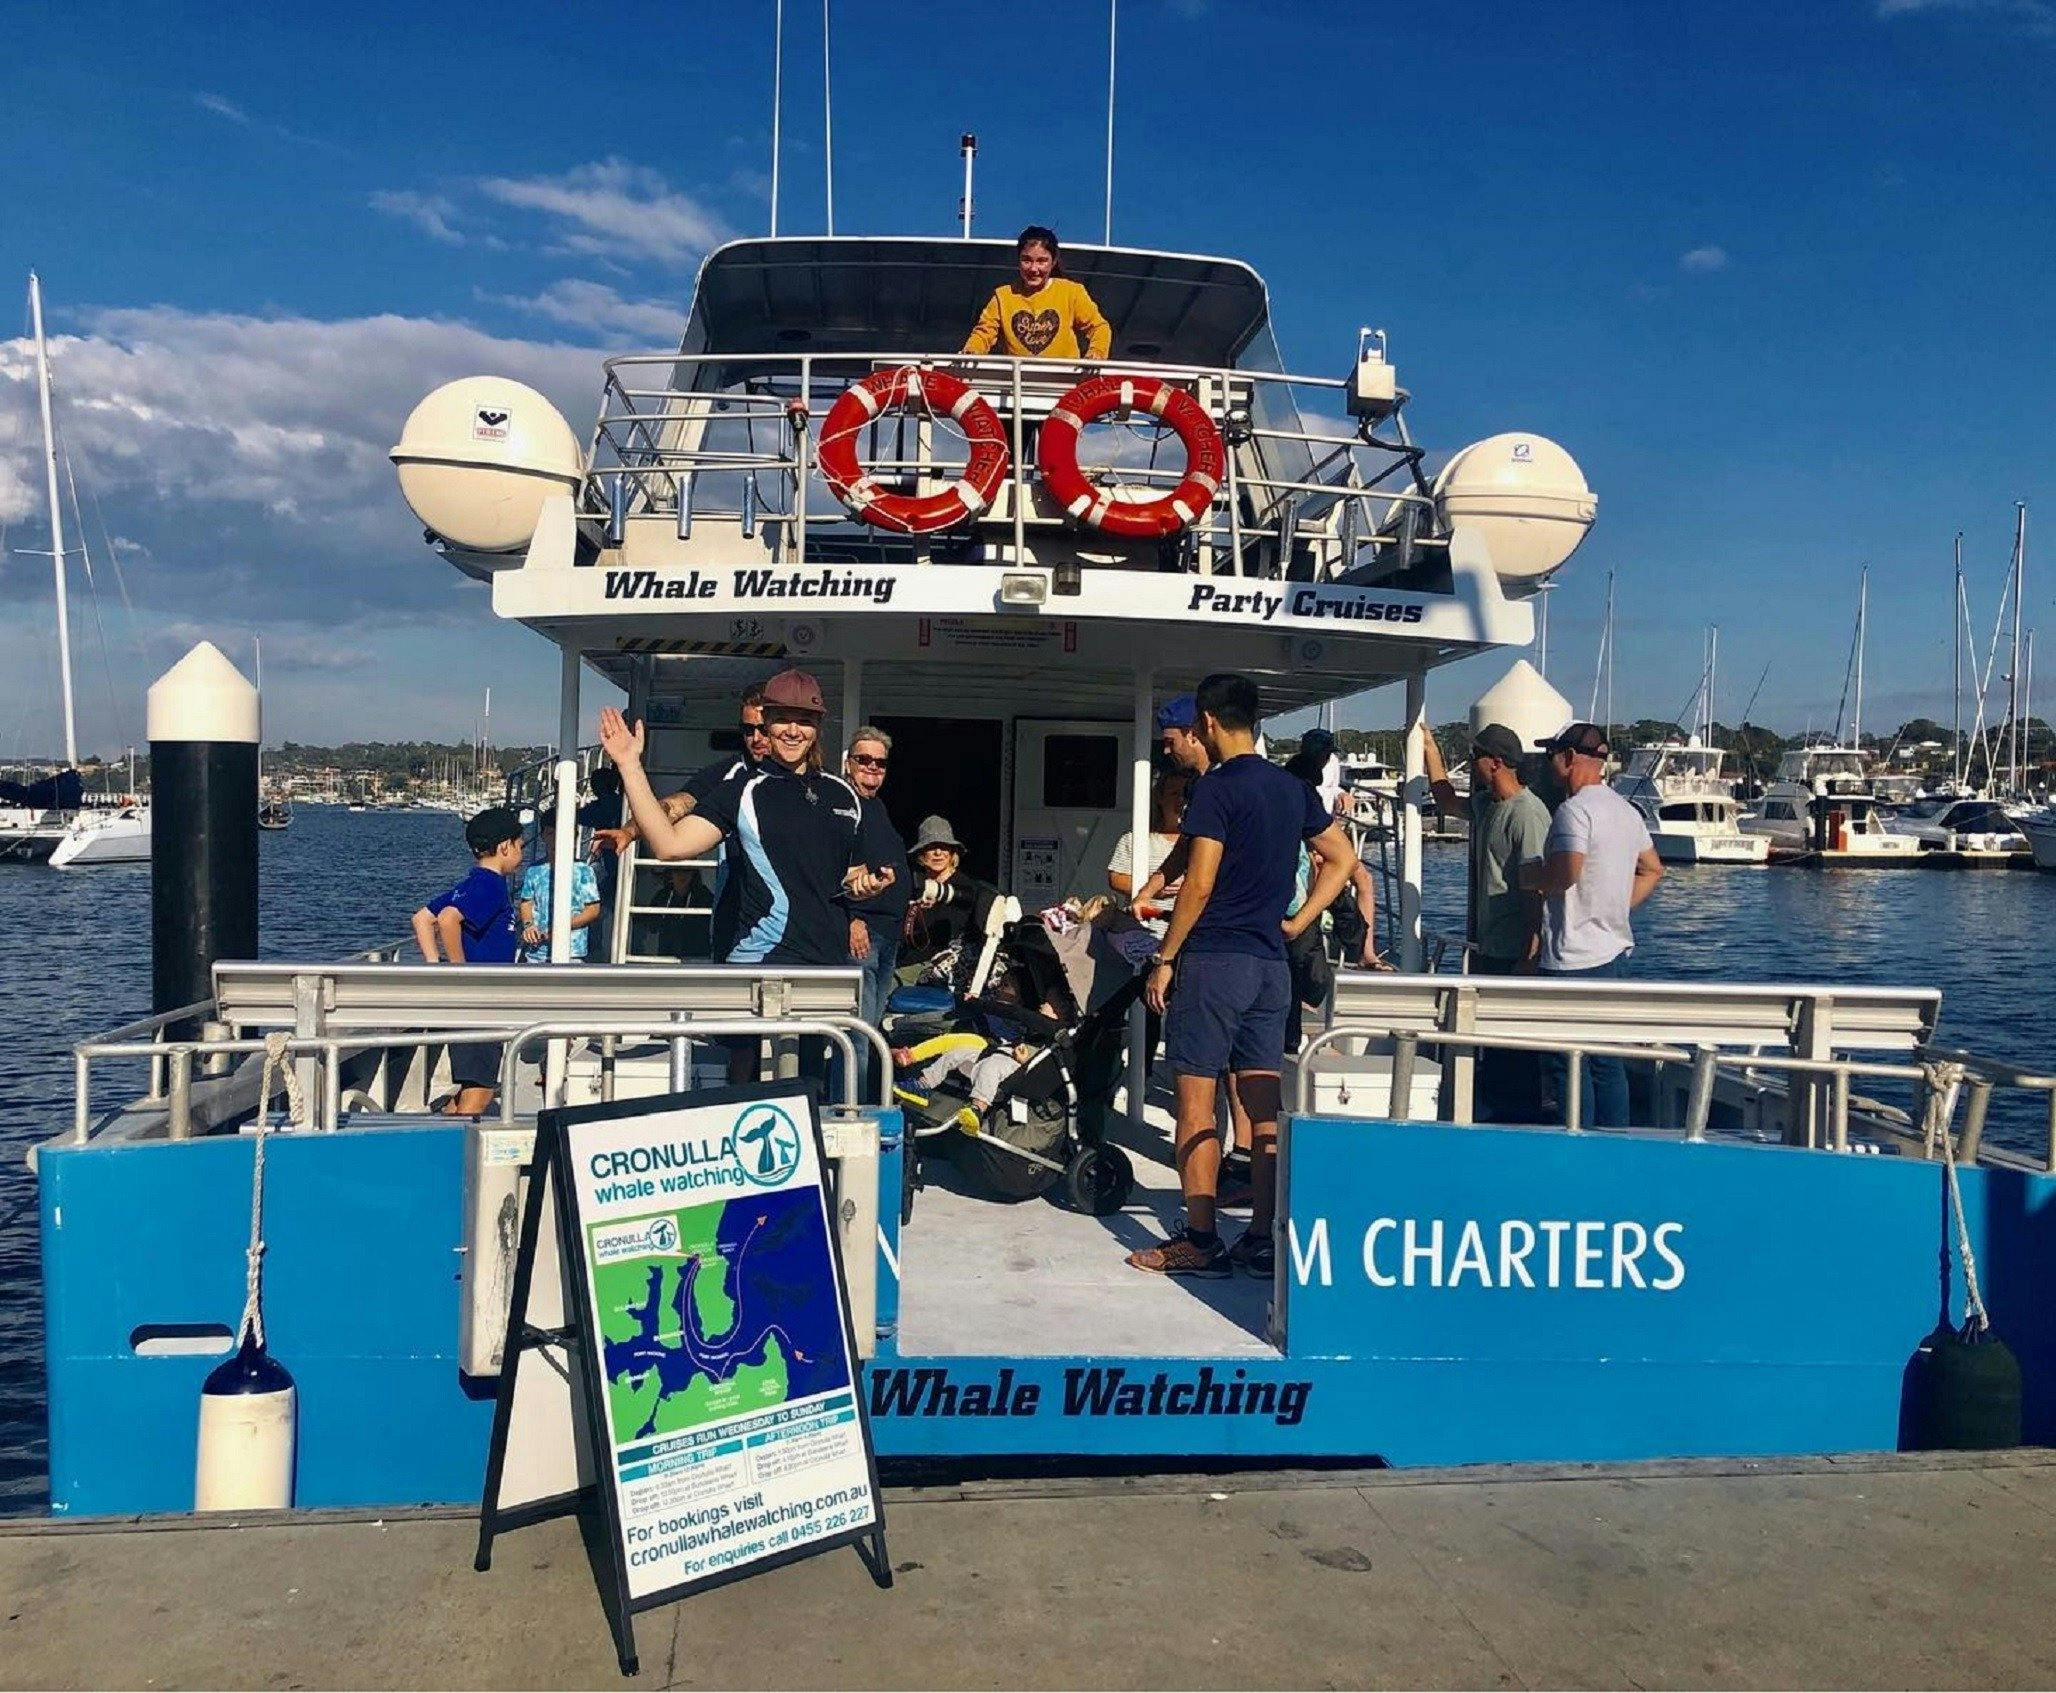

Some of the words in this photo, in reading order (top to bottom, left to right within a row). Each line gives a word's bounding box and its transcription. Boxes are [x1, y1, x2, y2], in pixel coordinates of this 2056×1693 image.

[870, 371, 938, 392] WHAE
[604, 571, 718, 599] Whale
[733, 569, 896, 604] Watching
[1187, 584, 1282, 620] Party
[1292, 590, 1423, 623] Cruises
[590, 1136, 738, 1179] CRONULLA
[594, 1178, 655, 1205] whale
[660, 1166, 745, 1193] watching
[596, 1231, 651, 1249] CRONULLA
[1363, 1217, 1685, 1290] CHARTERS
[870, 1368, 1041, 1416] Whale
[1062, 1366, 1313, 1425] Watching
[652, 1436, 695, 1455] CRUISES
[696, 1430, 717, 1443] RUN
[777, 1411, 789, 1423] TO
[790, 1402, 826, 1419] SUNDAY
[627, 1526, 653, 1544] For
[658, 1505, 730, 1535] bookings
[733, 1491, 764, 1514] visit
[630, 1484, 868, 1567] cronullawhalewatching.com.au
[684, 1559, 706, 1575] For
[708, 1539, 766, 1567] enquiries
[769, 1529, 789, 1548] call
[791, 1520, 822, 1541] 0455
[825, 1512, 848, 1531] 226
[849, 1505, 870, 1523] 227
